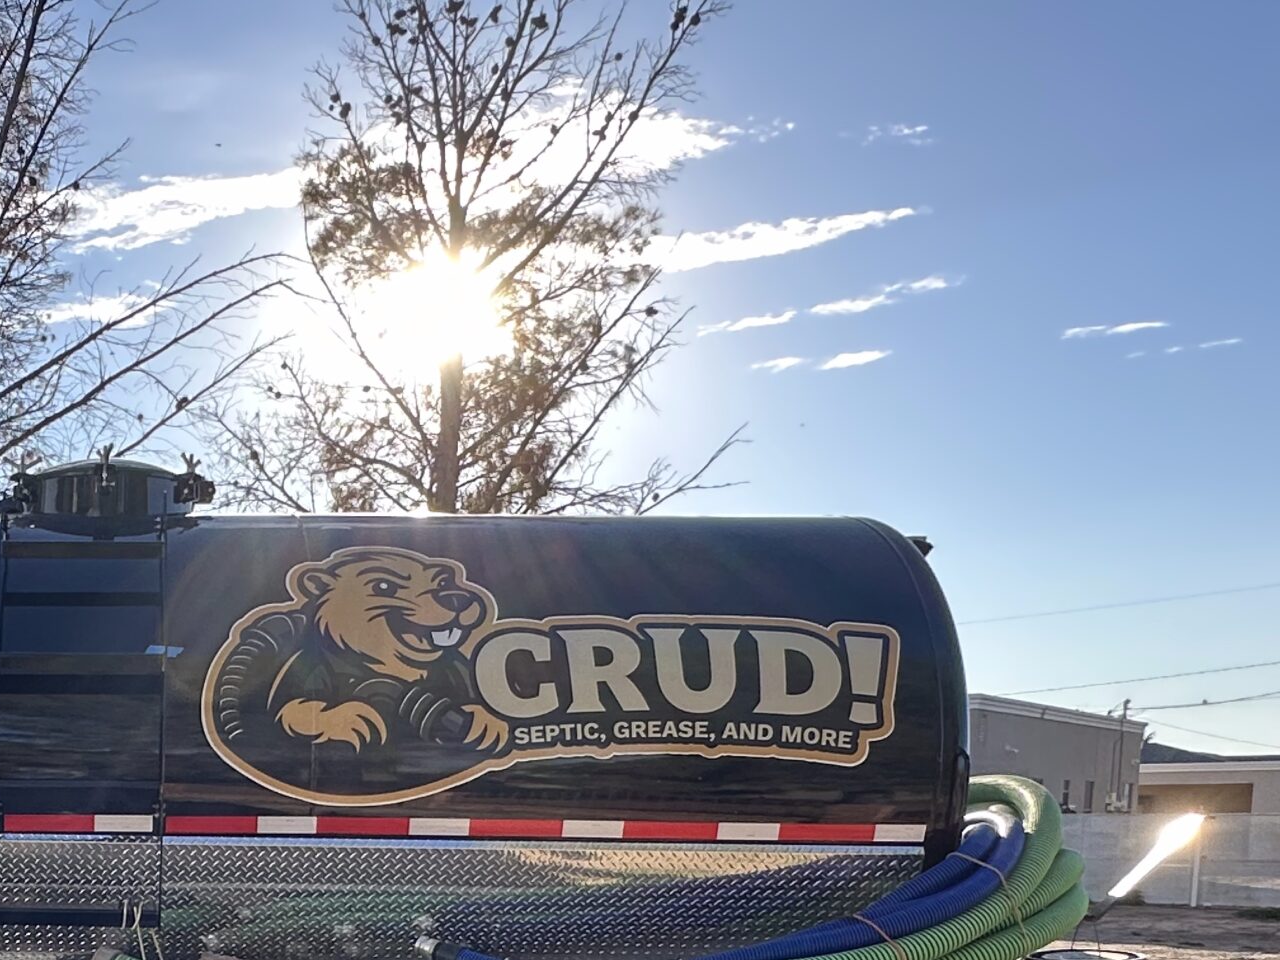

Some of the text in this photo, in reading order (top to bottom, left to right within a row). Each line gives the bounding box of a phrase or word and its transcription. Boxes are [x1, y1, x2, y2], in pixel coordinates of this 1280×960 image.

[475, 626, 883, 725] CRUD!
[514, 720, 853, 750] SEPTIC, GREASE, AND MORE
